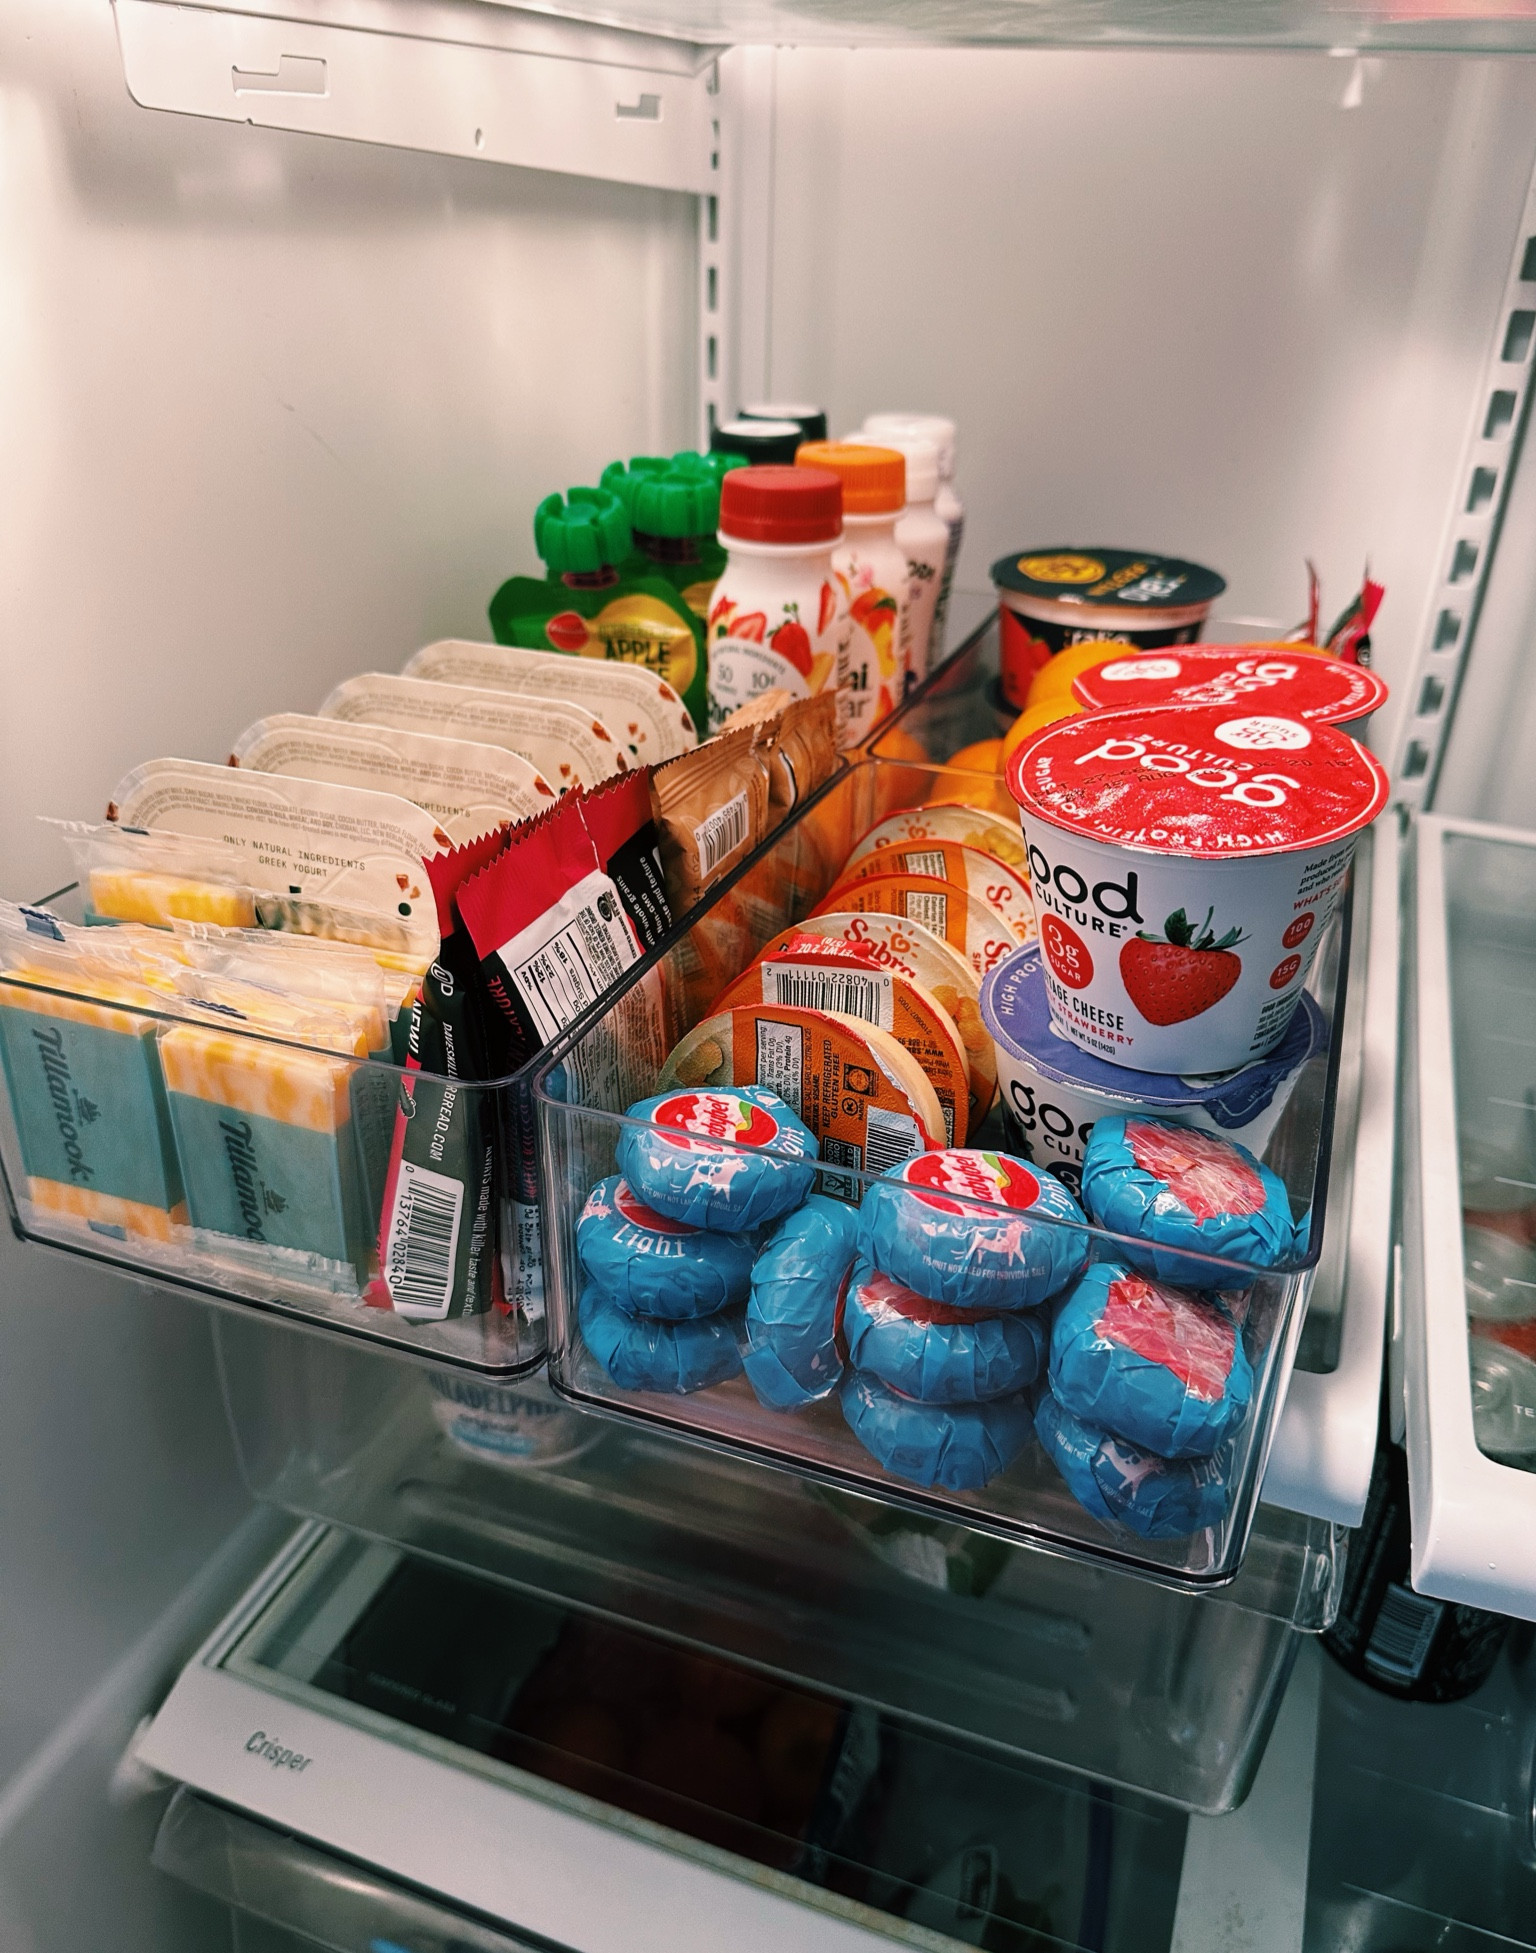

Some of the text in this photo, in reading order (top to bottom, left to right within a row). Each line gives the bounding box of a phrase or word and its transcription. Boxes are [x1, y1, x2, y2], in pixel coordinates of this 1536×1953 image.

[605, 638, 671, 664] APPLE
[1249, 719, 1299, 738] SUGAR
[1134, 733, 1254, 771] CULTURE
[1035, 756, 1057, 792] SUGAR
[1074, 739, 1300, 808] good
[1215, 830, 1285, 848] HIGH
[223, 834, 366, 873] ONLY NATURAL INGREDIENTS
[258, 854, 328, 878] GREEK YOGURT
[1304, 858, 1328, 874] Made
[640, 857, 666, 905] and texture
[1022, 832, 1144, 924] ood
[1299, 862, 1337, 887] produced
[617, 875, 637, 903] grains
[1293, 884, 1331, 911] WHAT'S
[1297, 883, 1314, 895] and
[634, 904, 649, 930] whole
[642, 893, 663, 934] Non-GMO
[1035, 882, 1121, 938] CULTURE
[1290, 918, 1311, 935] 100
[797, 943, 811, 954] OZ
[812, 945, 818, 954] 2
[1048, 924, 1080, 969] 3g
[533, 960, 546, 983] 12%
[541, 953, 555, 979] 23%
[555, 941, 585, 1000] Sugars 18%
[766, 967, 890, 987] 0 40822 01111 2
[1050, 954, 1081, 982] SUGAR
[1277, 961, 1298, 976] 15G
[1000, 986, 1018, 1017] HIGH
[1072, 996, 1124, 1031] CHEESE
[1058, 1002, 1134, 1046] STRAWBERRY
[760, 1026, 768, 1050] serving:
[786, 1035, 793, 1044] 4g
[759, 1051, 767, 1062] per
[767, 1051, 775, 1061] Fat
[775, 1055, 783, 1068] (3%
[784, 1044, 793, 1070] Protein
[766, 1061, 775, 1080] Trans
[775, 1069, 782, 1078] 9g
[793, 1071, 801, 1085] (4%
[429, 1021, 459, 1162] DAVESKILLRBREAD.COM
[822, 1039, 833, 1129] KEEP REFRIGERATED
[830, 1052, 840, 1119] GLUTEN FREE
[33, 1027, 96, 1181] Tillamook
[827, 1141, 835, 1163] NON
[833, 1141, 841, 1166] GMO
[482, 1146, 494, 1185] ALWAYS
[479, 1185, 491, 1211] made
[1035, 1175, 1075, 1220] Light
[389, 1165, 415, 1285] 0 13764 02840
[473, 1212, 488, 1233] with
[469, 1230, 487, 1255] killer
[612, 1223, 686, 1258] Light
[467, 1256, 482, 1281] taste
[982, 1269, 996, 1279] FOR
[1031, 1267, 1046, 1277] SALE
[466, 1280, 476, 1294] and
[1055, 1430, 1065, 1446] THIS
[245, 1730, 313, 1772] Crisper
